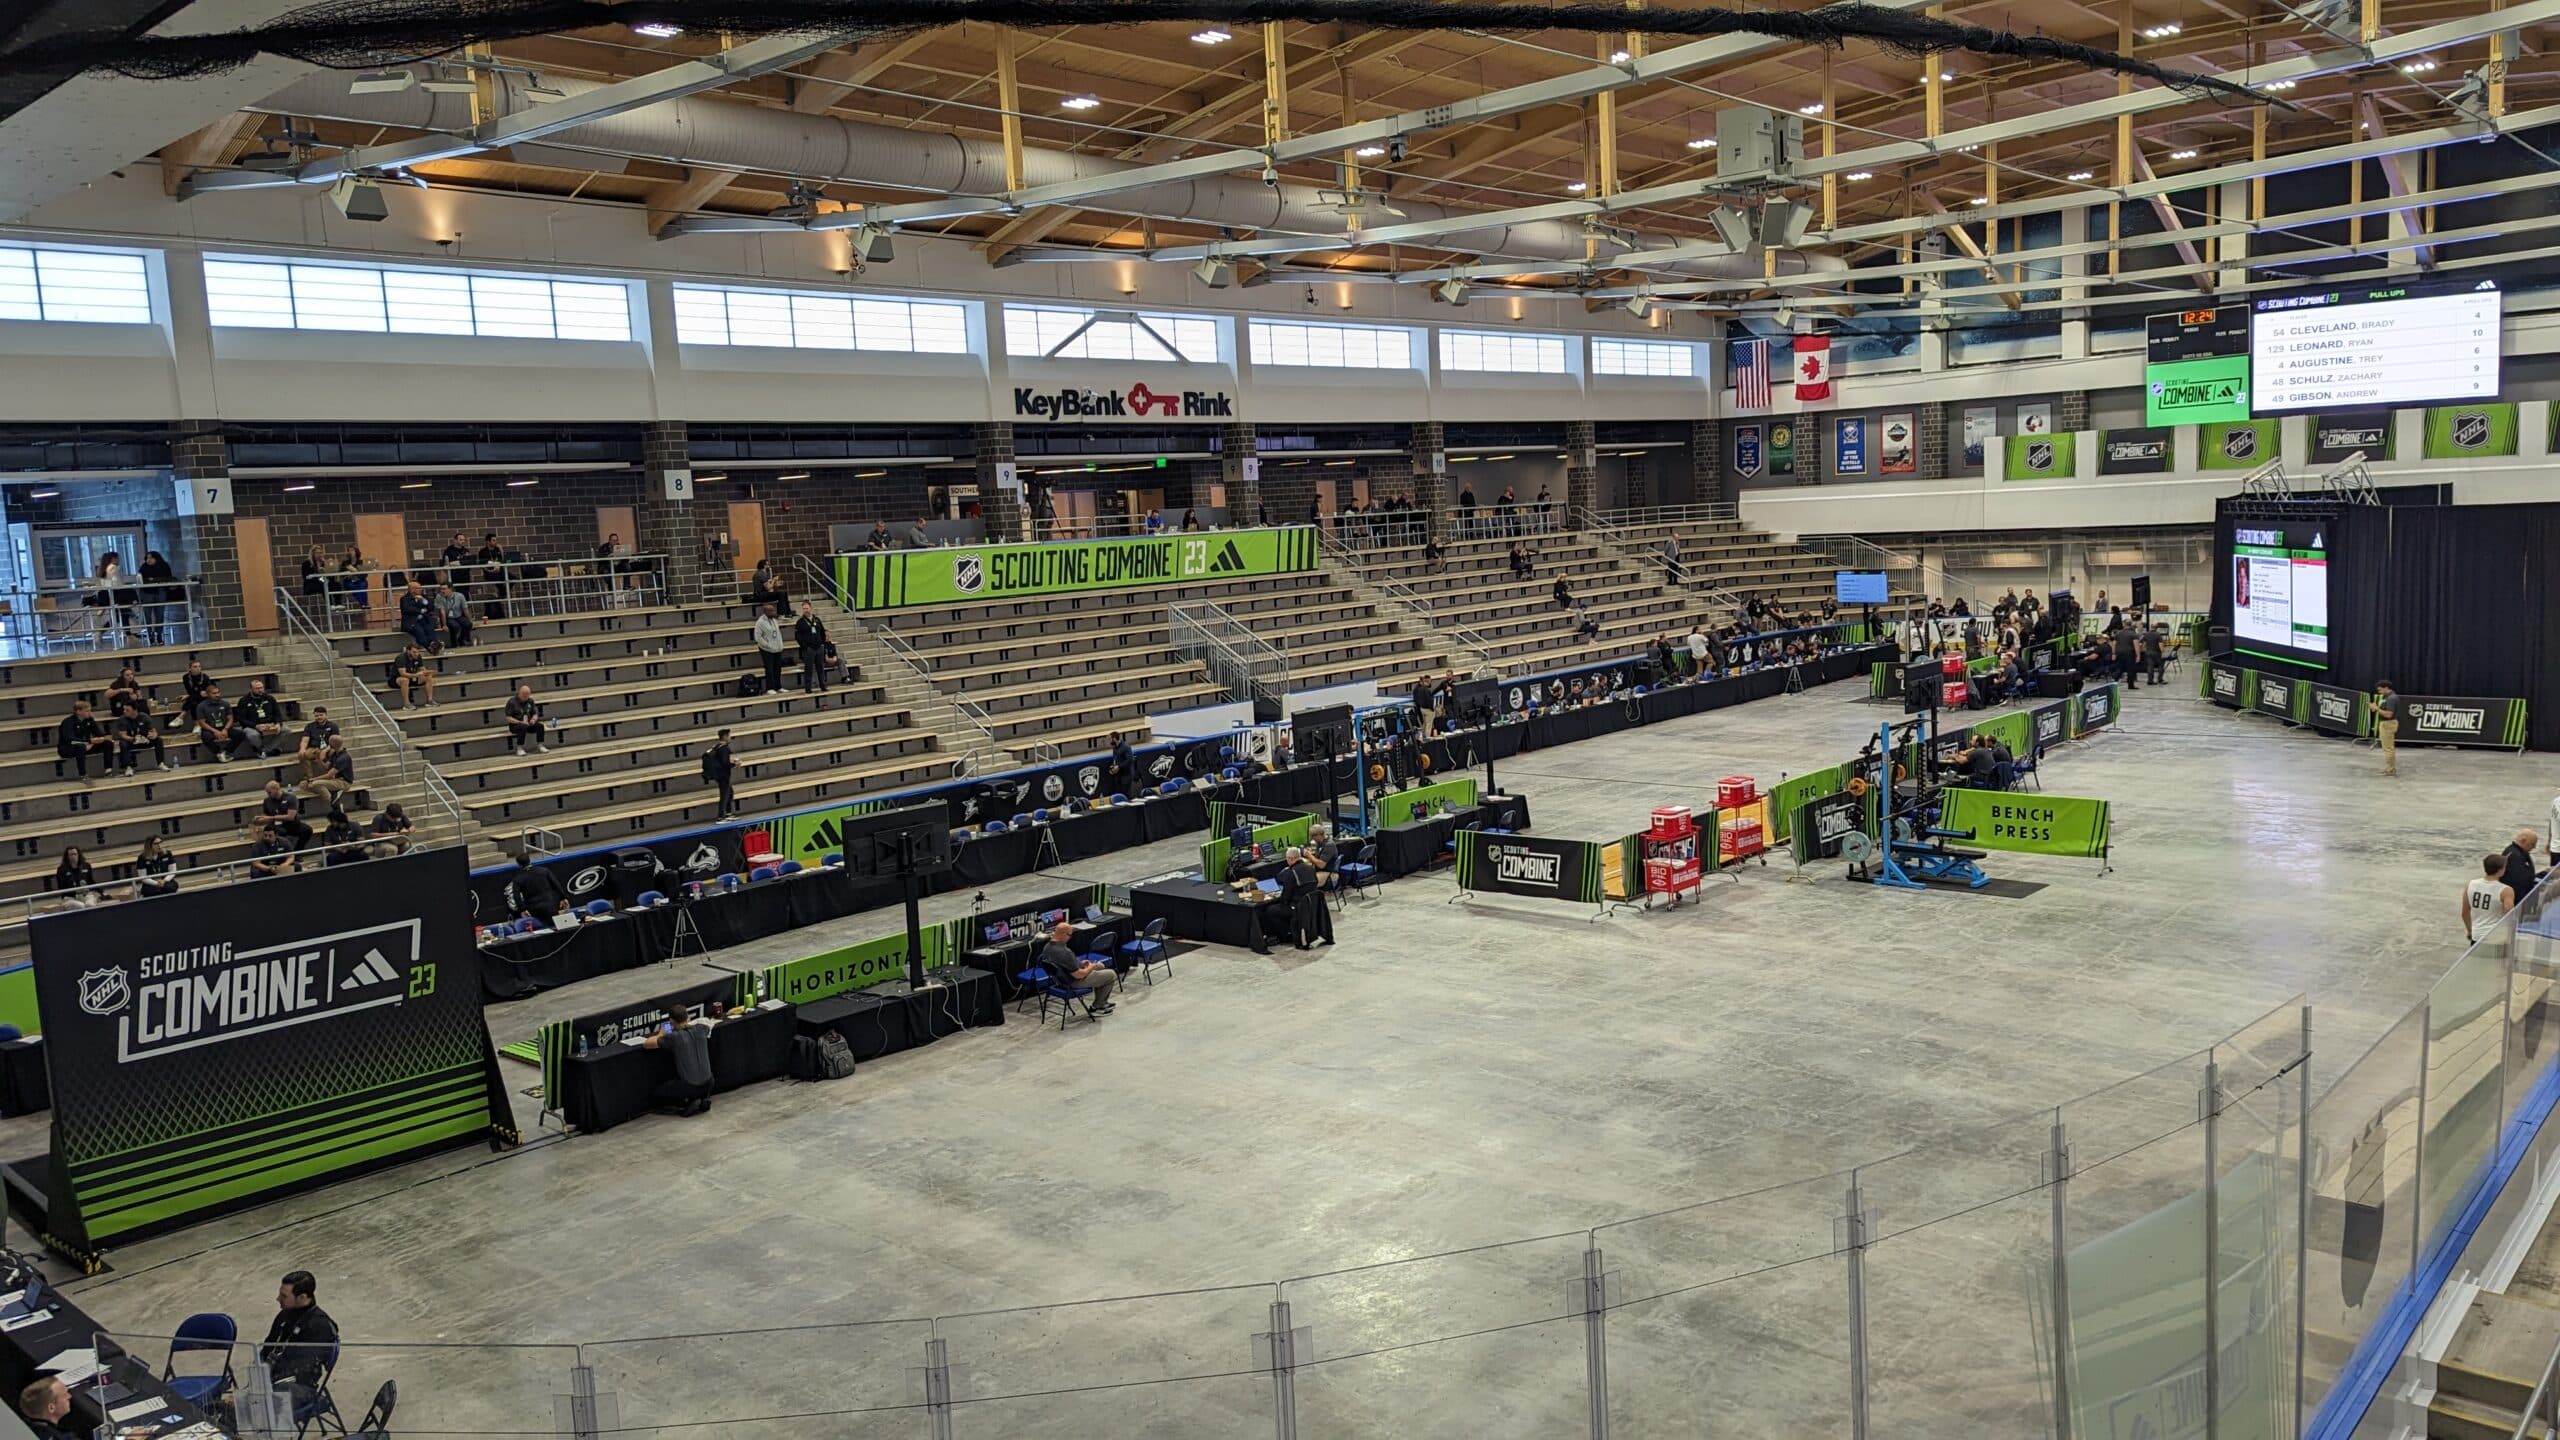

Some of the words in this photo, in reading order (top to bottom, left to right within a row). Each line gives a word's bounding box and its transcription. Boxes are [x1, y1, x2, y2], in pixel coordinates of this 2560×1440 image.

[2369, 290, 2388, 299] PULL
[2390, 289, 2405, 297] UPS
[2184, 311, 2213, 323] 12:24
[2273, 329, 2285, 337] 54
[2290, 322, 2359, 336] CLEVELAND,
[2361, 320, 2395, 329] BRADY
[2473, 329, 2483, 337] 10
[2268, 345, 2285, 353] 129
[2290, 339, 2346, 352] LEONARD,
[2348, 338, 2374, 347] RYAN
[2289, 356, 2356, 369] AUGUSTINE,
[2359, 354, 2384, 363] TREY
[2473, 364, 2480, 372] 9
[2272, 378, 2284, 386] 48
[2289, 374, 2335, 385] SCHULZ,
[2338, 372, 2384, 382] ZACHARY
[2473, 382, 2480, 390] 9
[2163, 384, 2212, 405] COMBINE
[2272, 394, 2284, 403] 49
[2289, 391, 2334, 402] GIBSON,
[2336, 389, 2378, 399] ANDREW
[1014, 387, 1126, 420] KeyBank
[1183, 391, 1232, 417] Rink
[2327, 432, 2362, 445] COMBINE
[2460, 421, 2484, 442] NHL
[2115, 446, 2145, 457] COMBINE
[2230, 435, 2251, 455] NHL
[1420, 459, 1427, 468] 10
[1436, 457, 1443, 467] 10
[2031, 447, 2050, 465] NHL
[1003, 470, 1010, 481] 9
[1230, 465, 1236, 475] 9
[1248, 464, 1253, 474] 9
[675, 478, 683, 491] 8
[206, 488, 218, 503] 7
[960, 563, 979, 587] NHL
[991, 548, 1088, 590] SCOUTING
[1095, 543, 1172, 582] COMBINE
[1185, 540, 1207, 575] 23
[2082, 618, 2099, 635] 23
[2422, 711, 2479, 729] COMBINE
[1800, 785, 1817, 797] PRO
[1410, 796, 1445, 814] BNCH
[1992, 805, 2053, 822] BENCH
[1995, 824, 2050, 841] PRESS
[1504, 845, 1529, 855] SCOUTING
[1502, 855, 1555, 881] COMBINE
[1651, 866, 1667, 875] BIO
[2472, 891, 2491, 910] 88
[1010, 911, 1039, 926] SCOUTING
[140, 941, 232, 979] SCOUTING
[92, 977, 119, 1007] NHL
[138, 952, 321, 1044] COMBINE
[409, 962, 436, 999] 23
[623, 1009, 660, 1030] SCOUTING
